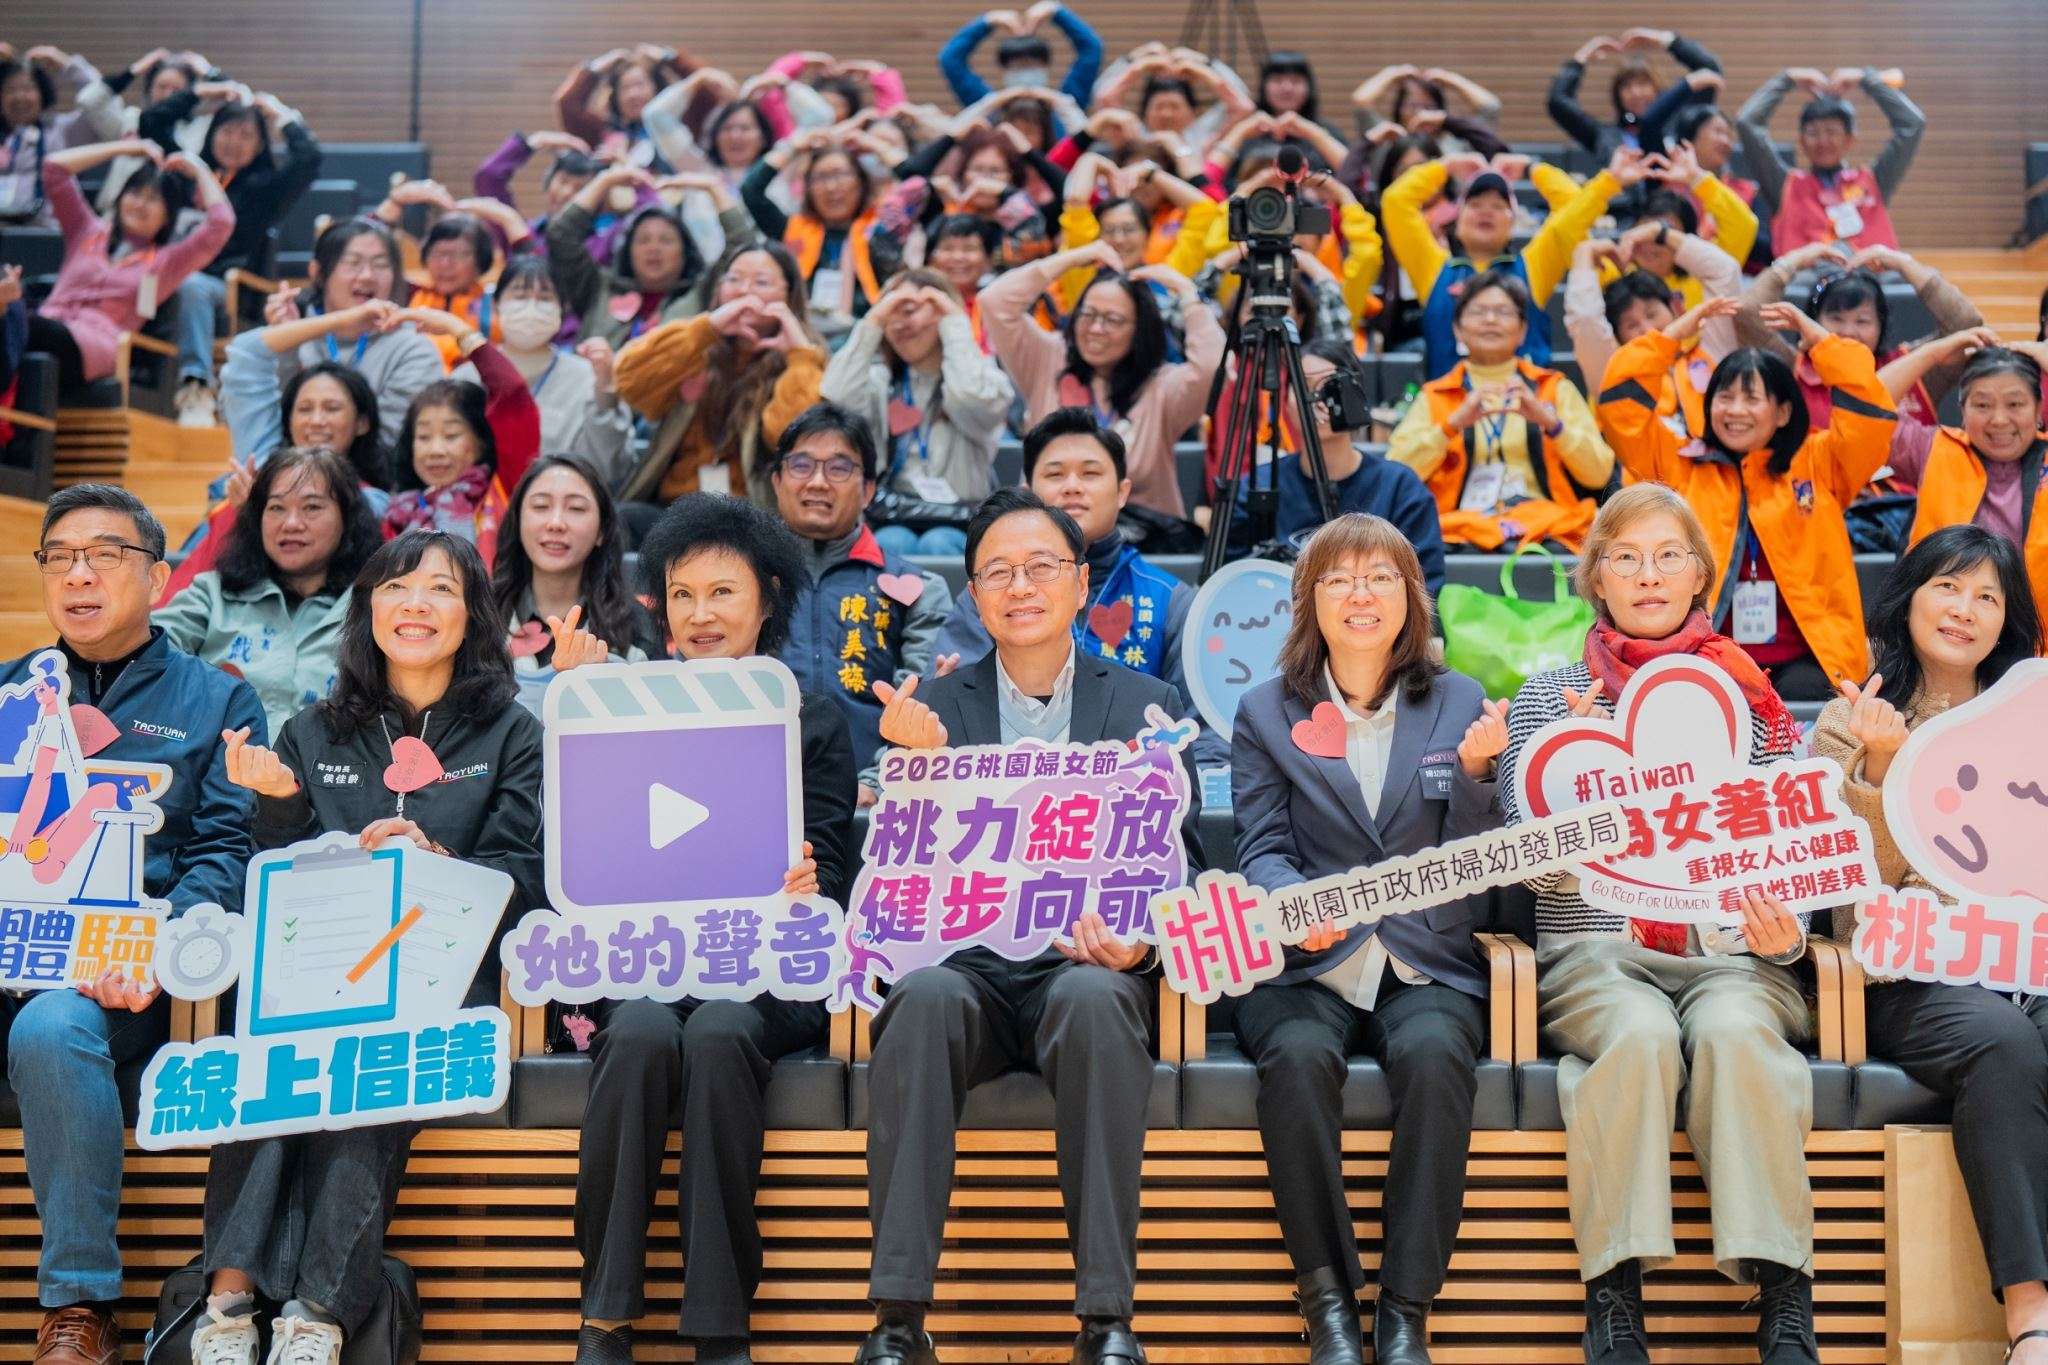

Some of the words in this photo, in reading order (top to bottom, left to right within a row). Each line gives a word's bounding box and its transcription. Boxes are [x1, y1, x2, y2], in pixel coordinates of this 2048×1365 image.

[133, 720, 187, 739] TAOYUAN
[885, 750, 1119, 782] 2026桃園婦女節
[1574, 762, 1694, 803] #Taiwan
[868, 793, 1178, 867] 桃力綻放
[1685, 829, 1860, 884] 重視女人心健康
[858, 868, 1168, 942] 健步向前
[1278, 812, 1619, 933] 桃園市政府婦幼發展局
[516, 902, 837, 991] 她的聲音
[1861, 894, 2048, 988] 桃力
[150, 1020, 496, 1135] 線上倡議
